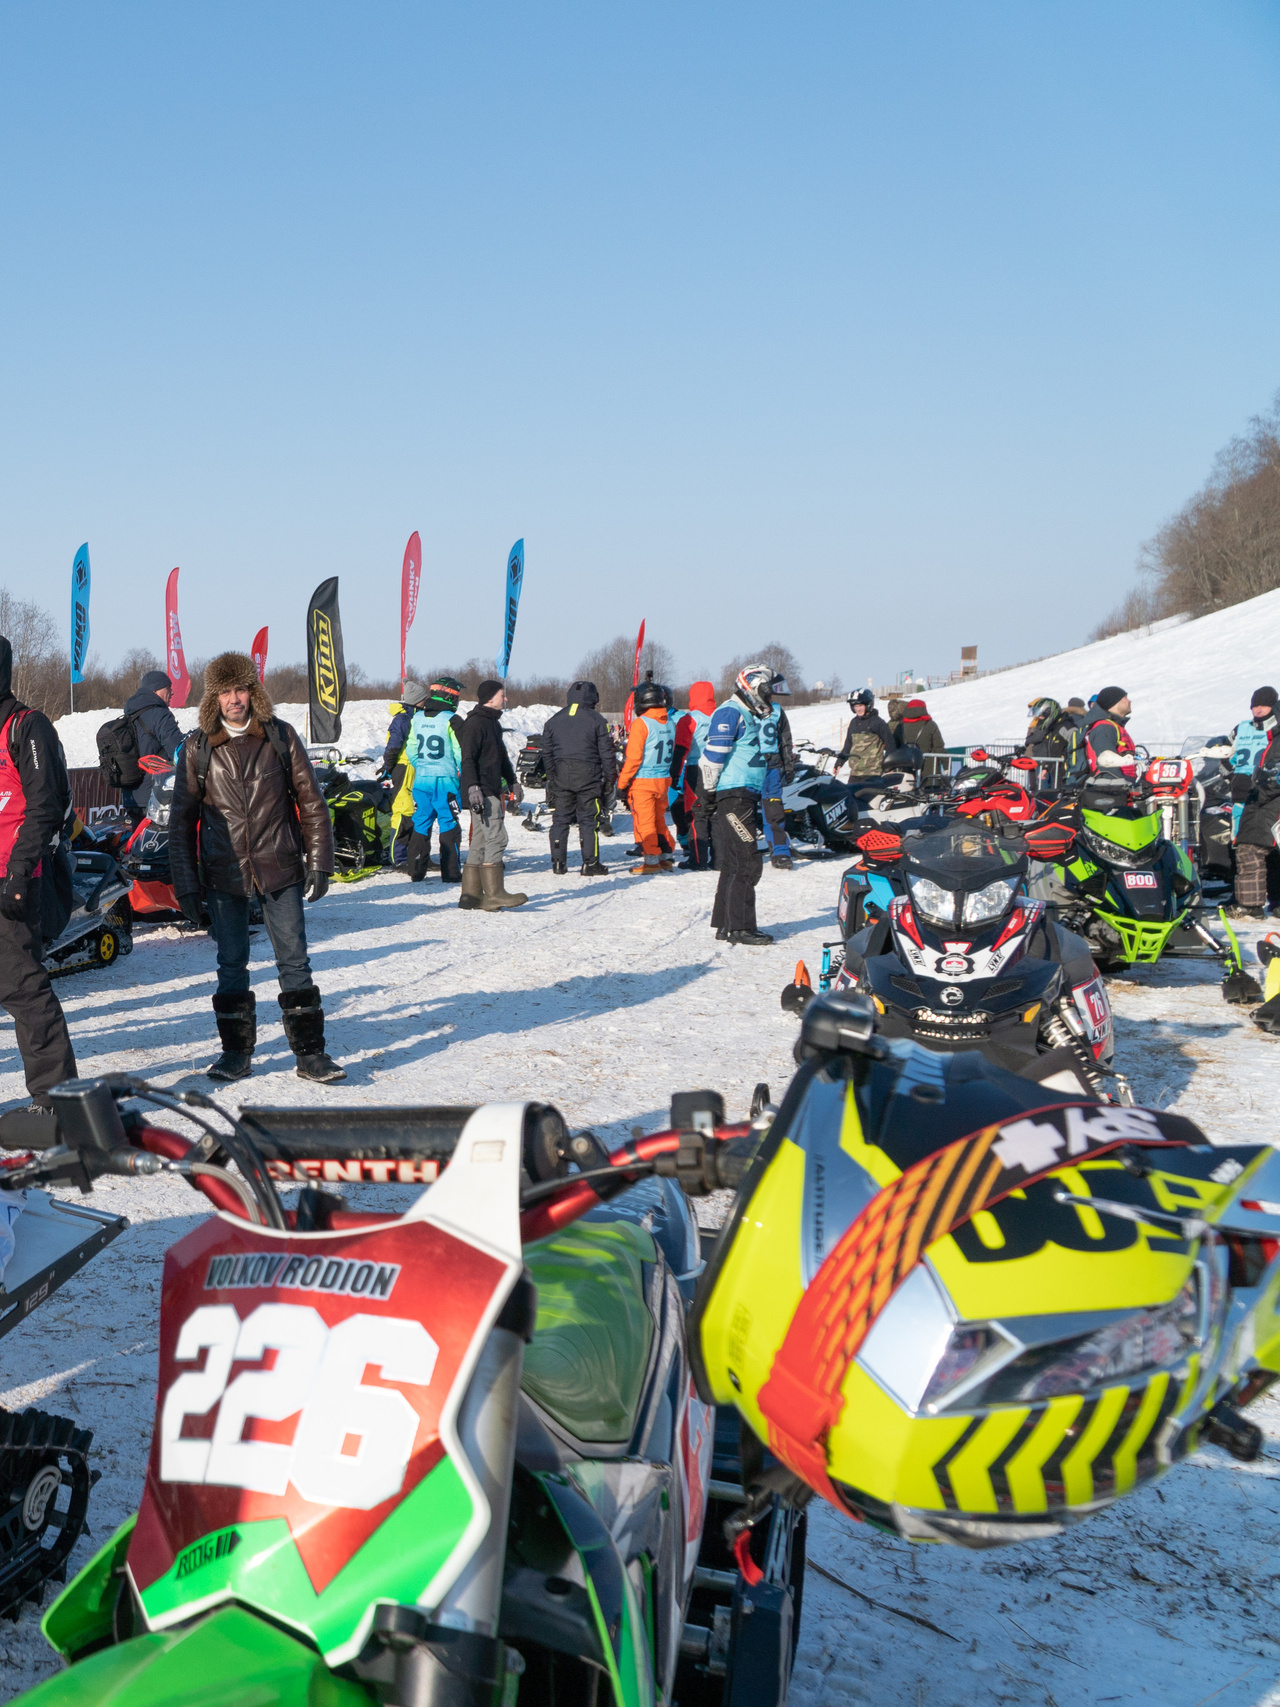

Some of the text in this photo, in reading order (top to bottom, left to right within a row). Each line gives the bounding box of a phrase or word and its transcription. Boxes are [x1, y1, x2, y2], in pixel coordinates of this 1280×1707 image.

[30, 739, 40, 770] SALOMON
[653, 739, 674, 765] 13
[1162, 763, 1178, 777] 36
[825, 800, 848, 825] LYNX
[726, 812, 755, 843] SCOTT
[1126, 874, 1154, 886] 800
[988, 954, 1004, 972] LYNX
[206, 1255, 398, 1299] VOLKOV RODION
[160, 1301, 440, 1511] 226
